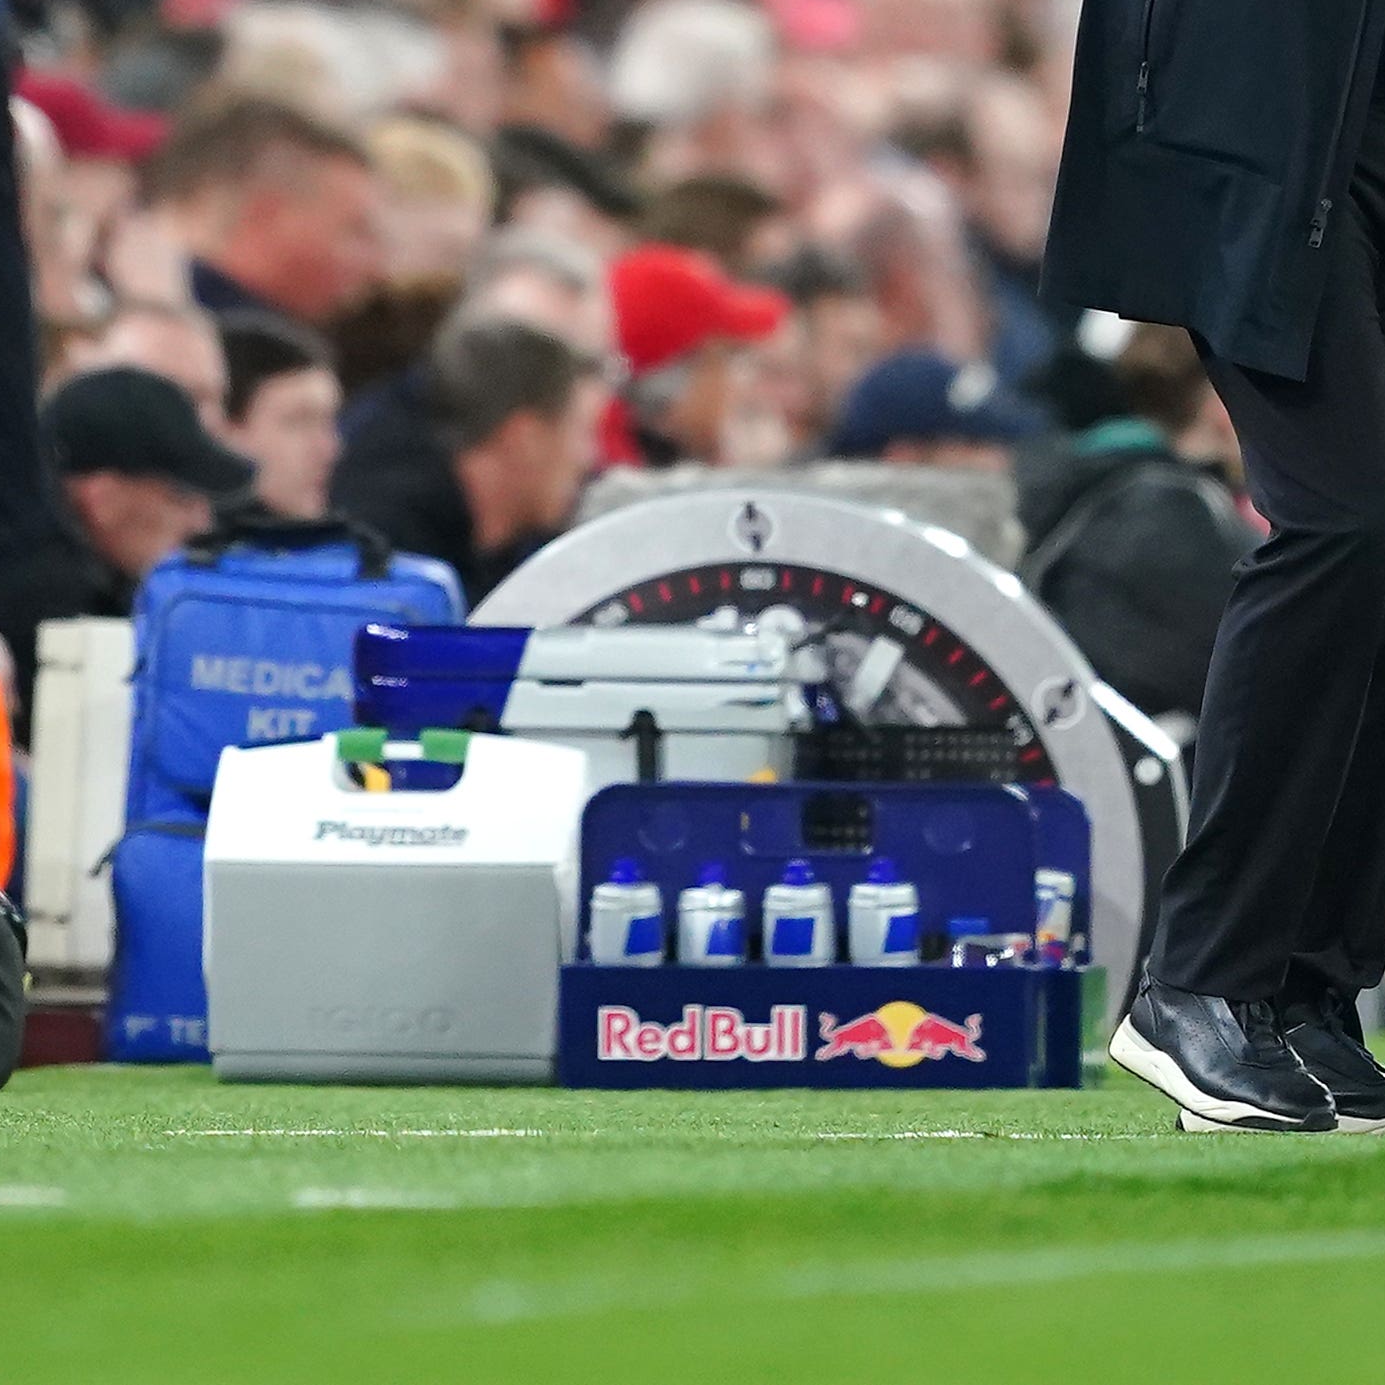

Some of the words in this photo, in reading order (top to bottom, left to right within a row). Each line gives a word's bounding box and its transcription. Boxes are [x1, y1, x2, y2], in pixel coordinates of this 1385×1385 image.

[191, 655, 354, 700] MEDICA
[248, 706, 315, 740] KIT
[314, 820, 469, 846] Playmate
[597, 1005, 703, 1061] Red
[704, 1005, 807, 1062] Bull
